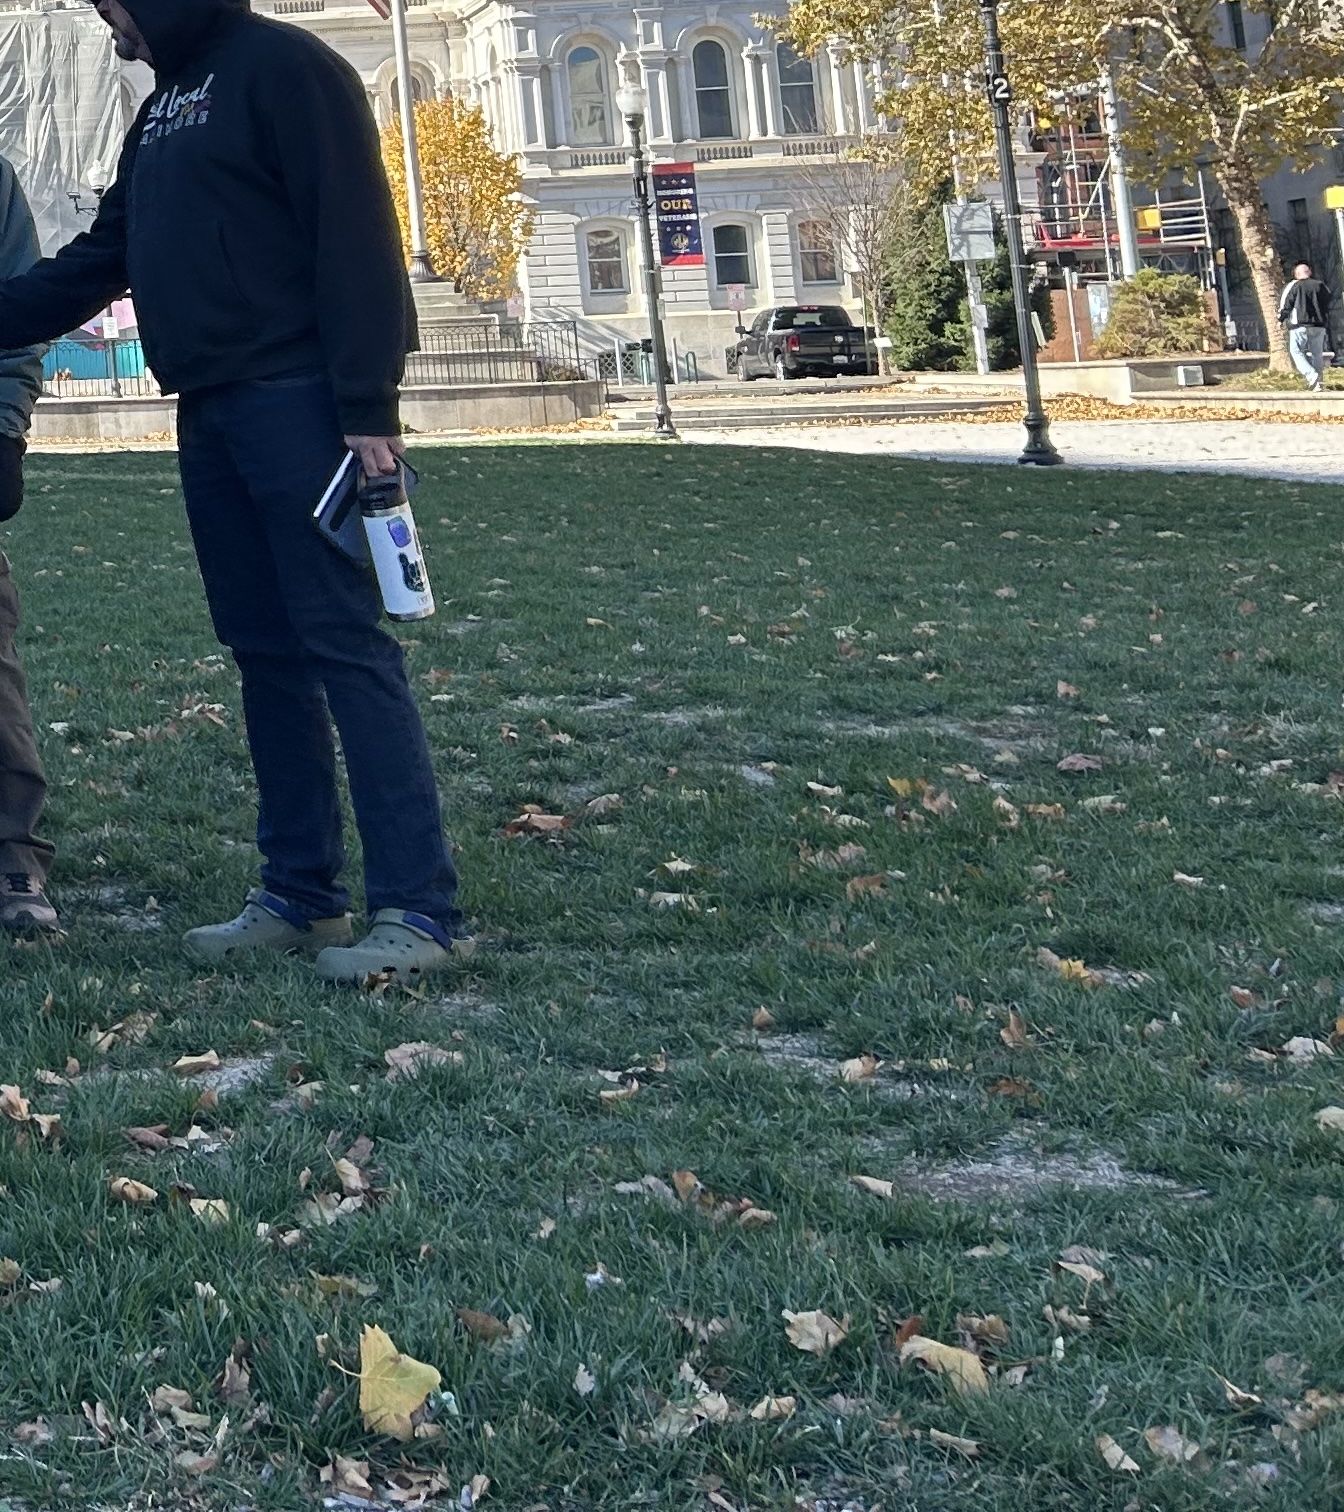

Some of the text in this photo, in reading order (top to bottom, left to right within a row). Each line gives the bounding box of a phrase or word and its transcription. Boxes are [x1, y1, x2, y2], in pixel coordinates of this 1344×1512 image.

[994, 77, 1010, 99] 2
[660, 198, 693, 211] OUR
[658, 212, 698, 222] VETERA
